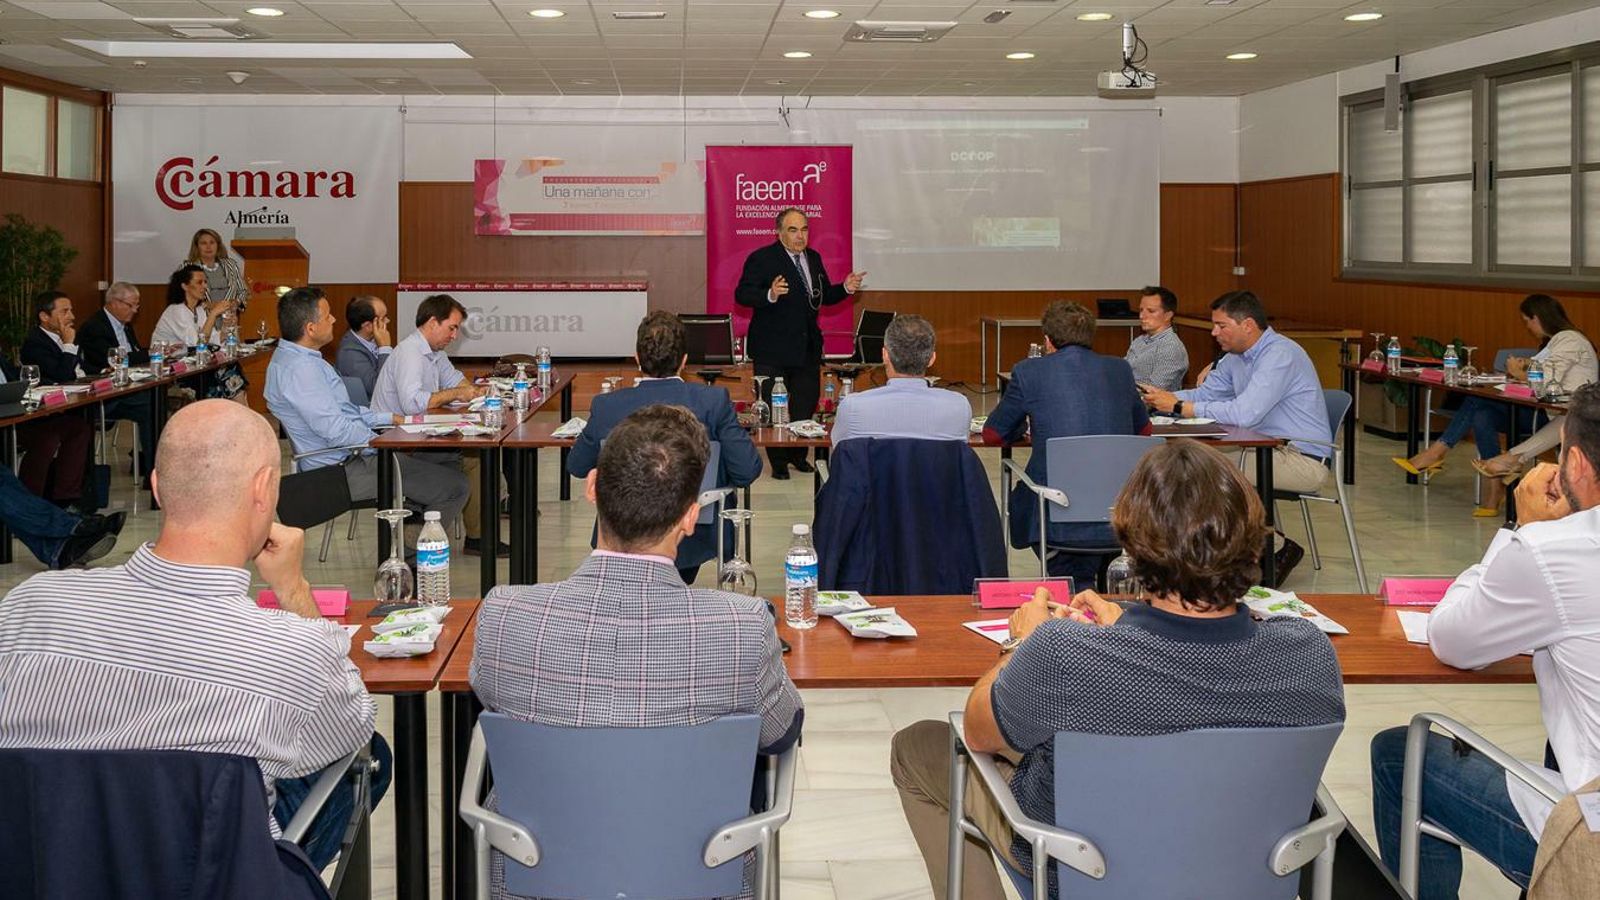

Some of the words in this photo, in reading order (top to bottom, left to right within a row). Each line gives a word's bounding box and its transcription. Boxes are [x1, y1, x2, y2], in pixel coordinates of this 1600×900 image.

[544, 185, 570, 198] Una
[573, 186, 626, 198] mañana
[736, 173, 803, 201] faeem
[224, 209, 289, 227] Almería
